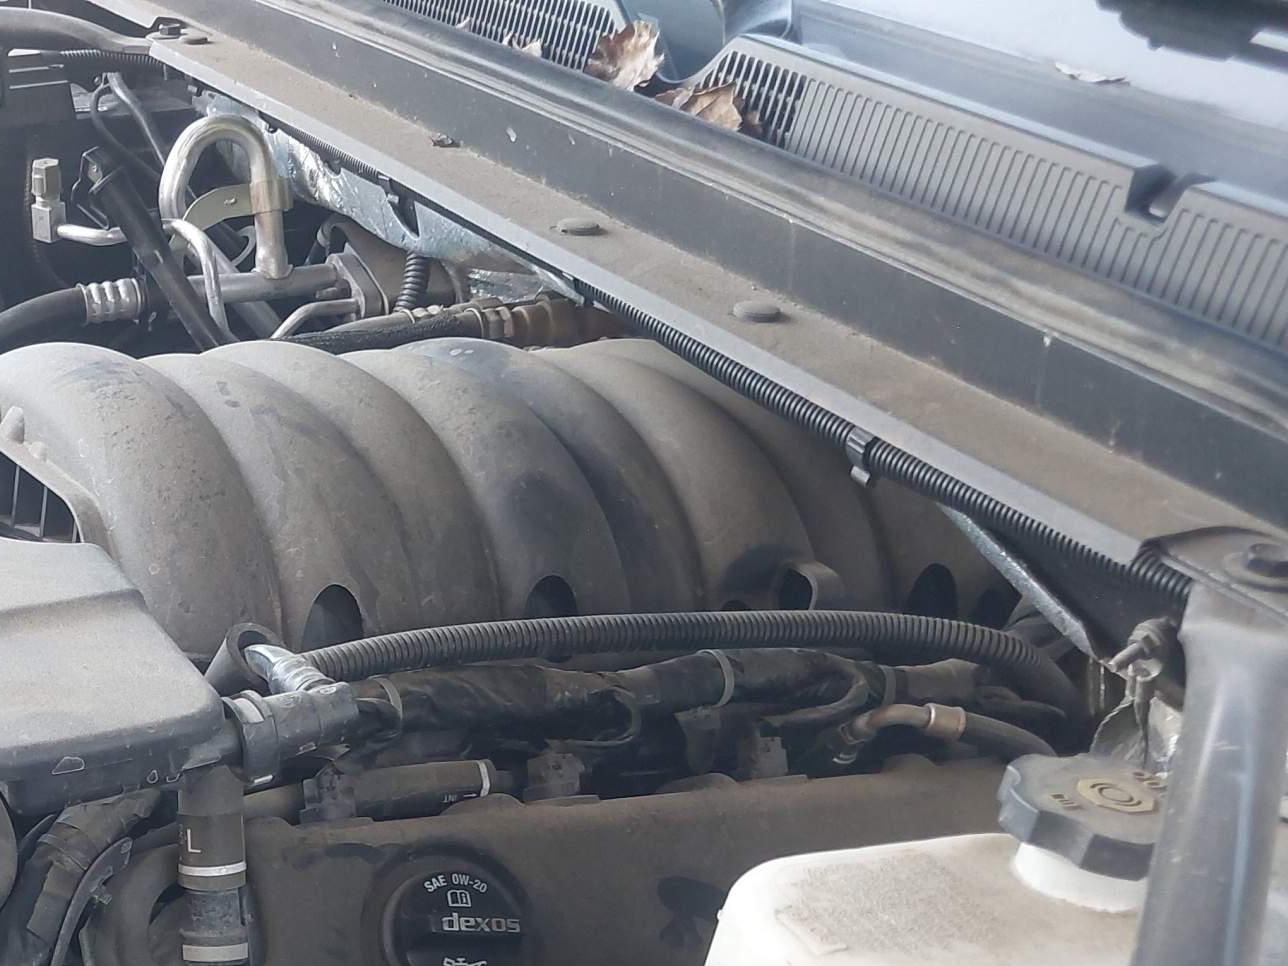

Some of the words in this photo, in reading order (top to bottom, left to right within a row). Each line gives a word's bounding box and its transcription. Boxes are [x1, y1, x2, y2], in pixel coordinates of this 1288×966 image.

[186, 828, 202, 853] L
[423, 874, 448, 893] SAE
[451, 872, 488, 893] 0W-20
[441, 912, 521, 933] dexos
